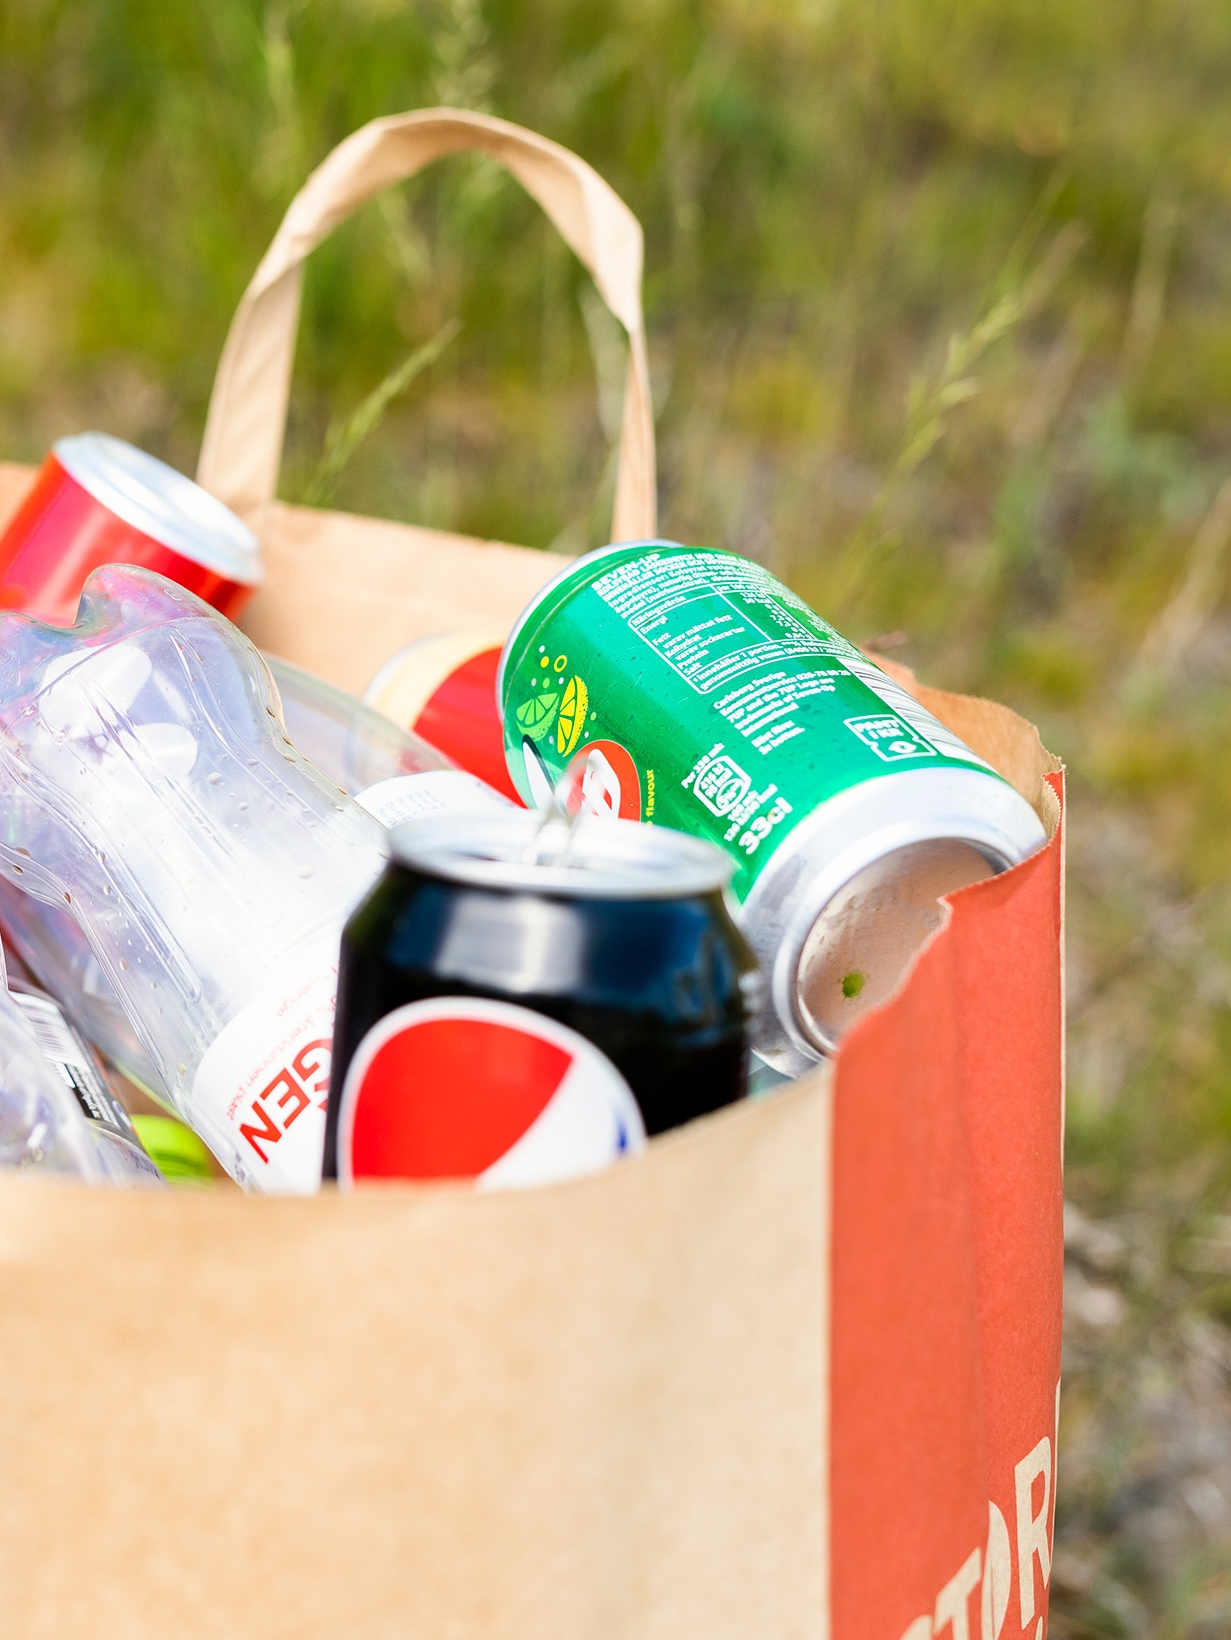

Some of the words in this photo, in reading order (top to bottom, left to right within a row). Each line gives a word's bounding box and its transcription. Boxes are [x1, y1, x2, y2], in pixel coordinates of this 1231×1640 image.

[591, 554, 660, 591] SEVEN-UP
[596, 569, 640, 597] KOLSYRAD
[602, 571, 655, 602] INNEHÅLLER
[653, 561, 687, 575] SOCKER
[608, 574, 669, 608] Ingredienser:
[620, 599, 646, 619] medel
[630, 596, 686, 626] Näringsvärde
[640, 615, 668, 634] Energi
[652, 633, 671, 646] Fett
[663, 633, 686, 649] varav
[686, 620, 716, 636] mättat
[714, 615, 733, 623] fett
[664, 634, 702, 658] Kolhydrat
[675, 645, 698, 661] varav
[698, 627, 745, 648] sockerarter
[677, 649, 709, 669] Protein
[683, 662, 702, 676] Salt
[700, 657, 760, 691] genomsnittlig
[714, 684, 755, 709] Carlsberg
[752, 672, 786, 687] Sverige
[720, 677, 797, 716] Konsumentservice
[727, 708, 745, 723] 7UP
[745, 698, 764, 712] and
[762, 692, 779, 702] the
[777, 684, 796, 695] 7UP
[796, 680, 820, 689] Logo
[734, 700, 784, 730] trademarks
[783, 694, 794, 703] of
[792, 685, 835, 699] Seven-Up
[741, 702, 799, 737] International
[751, 731, 774, 748] Bäst
[853, 720, 899, 732] PANT
[876, 728, 904, 738] KR
[759, 744, 772, 755] Se
[681, 772, 696, 789] Per
[694, 756, 710, 773] 330
[701, 773, 717, 789] 416
[646, 769, 655, 817] flavour
[739, 798, 792, 854] 33cl
